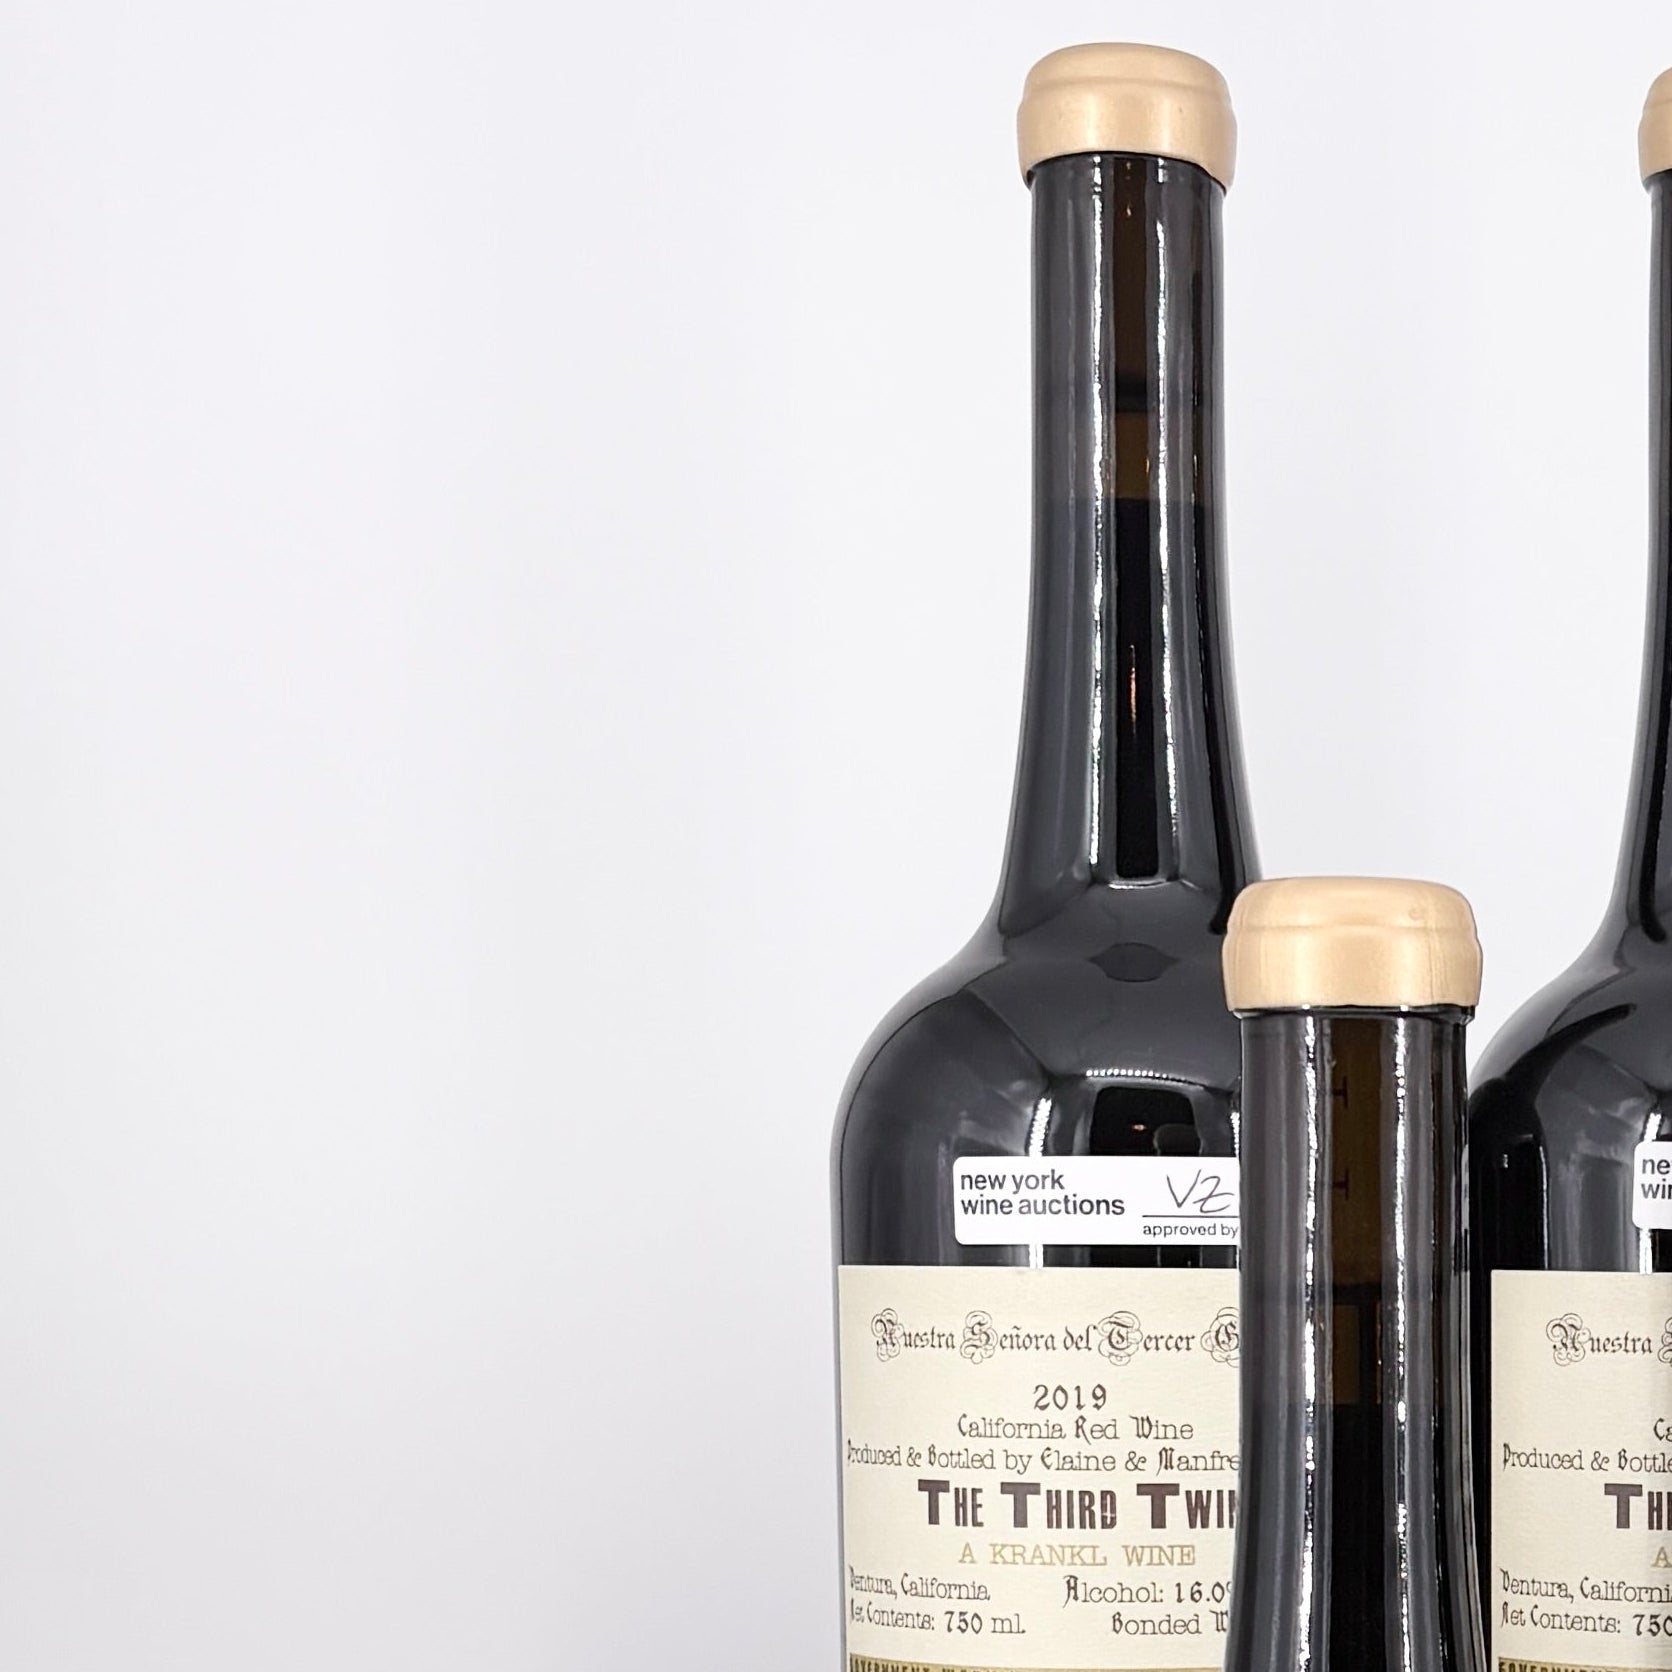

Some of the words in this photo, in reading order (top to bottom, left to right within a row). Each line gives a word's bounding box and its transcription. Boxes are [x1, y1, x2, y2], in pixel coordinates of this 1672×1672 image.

[961, 1174, 1006, 1190] new
[1011, 1169, 1065, 1195] york
[961, 1194, 1013, 1215] wine
[1018, 1195, 1125, 1215] auctions
[1143, 1223, 1216, 1238] approved
[1220, 1222, 1239, 1239] by
[960, 1310, 1057, 1364] Señora
[1063, 1324, 1098, 1351] del
[1098, 1311, 1195, 1366] Tercer
[1033, 1384, 1106, 1411] 2019
[957, 1413, 1066, 1439] California
[1075, 1415, 1120, 1445] Red
[1129, 1415, 1193, 1440] Wine
[918, 1479, 984, 1527] THE
[1000, 1482, 1117, 1530] THIRD
[958, 1542, 976, 1564] A
[989, 1543, 1107, 1566] KRANKL
[1121, 1544, 1196, 1566] WINE
